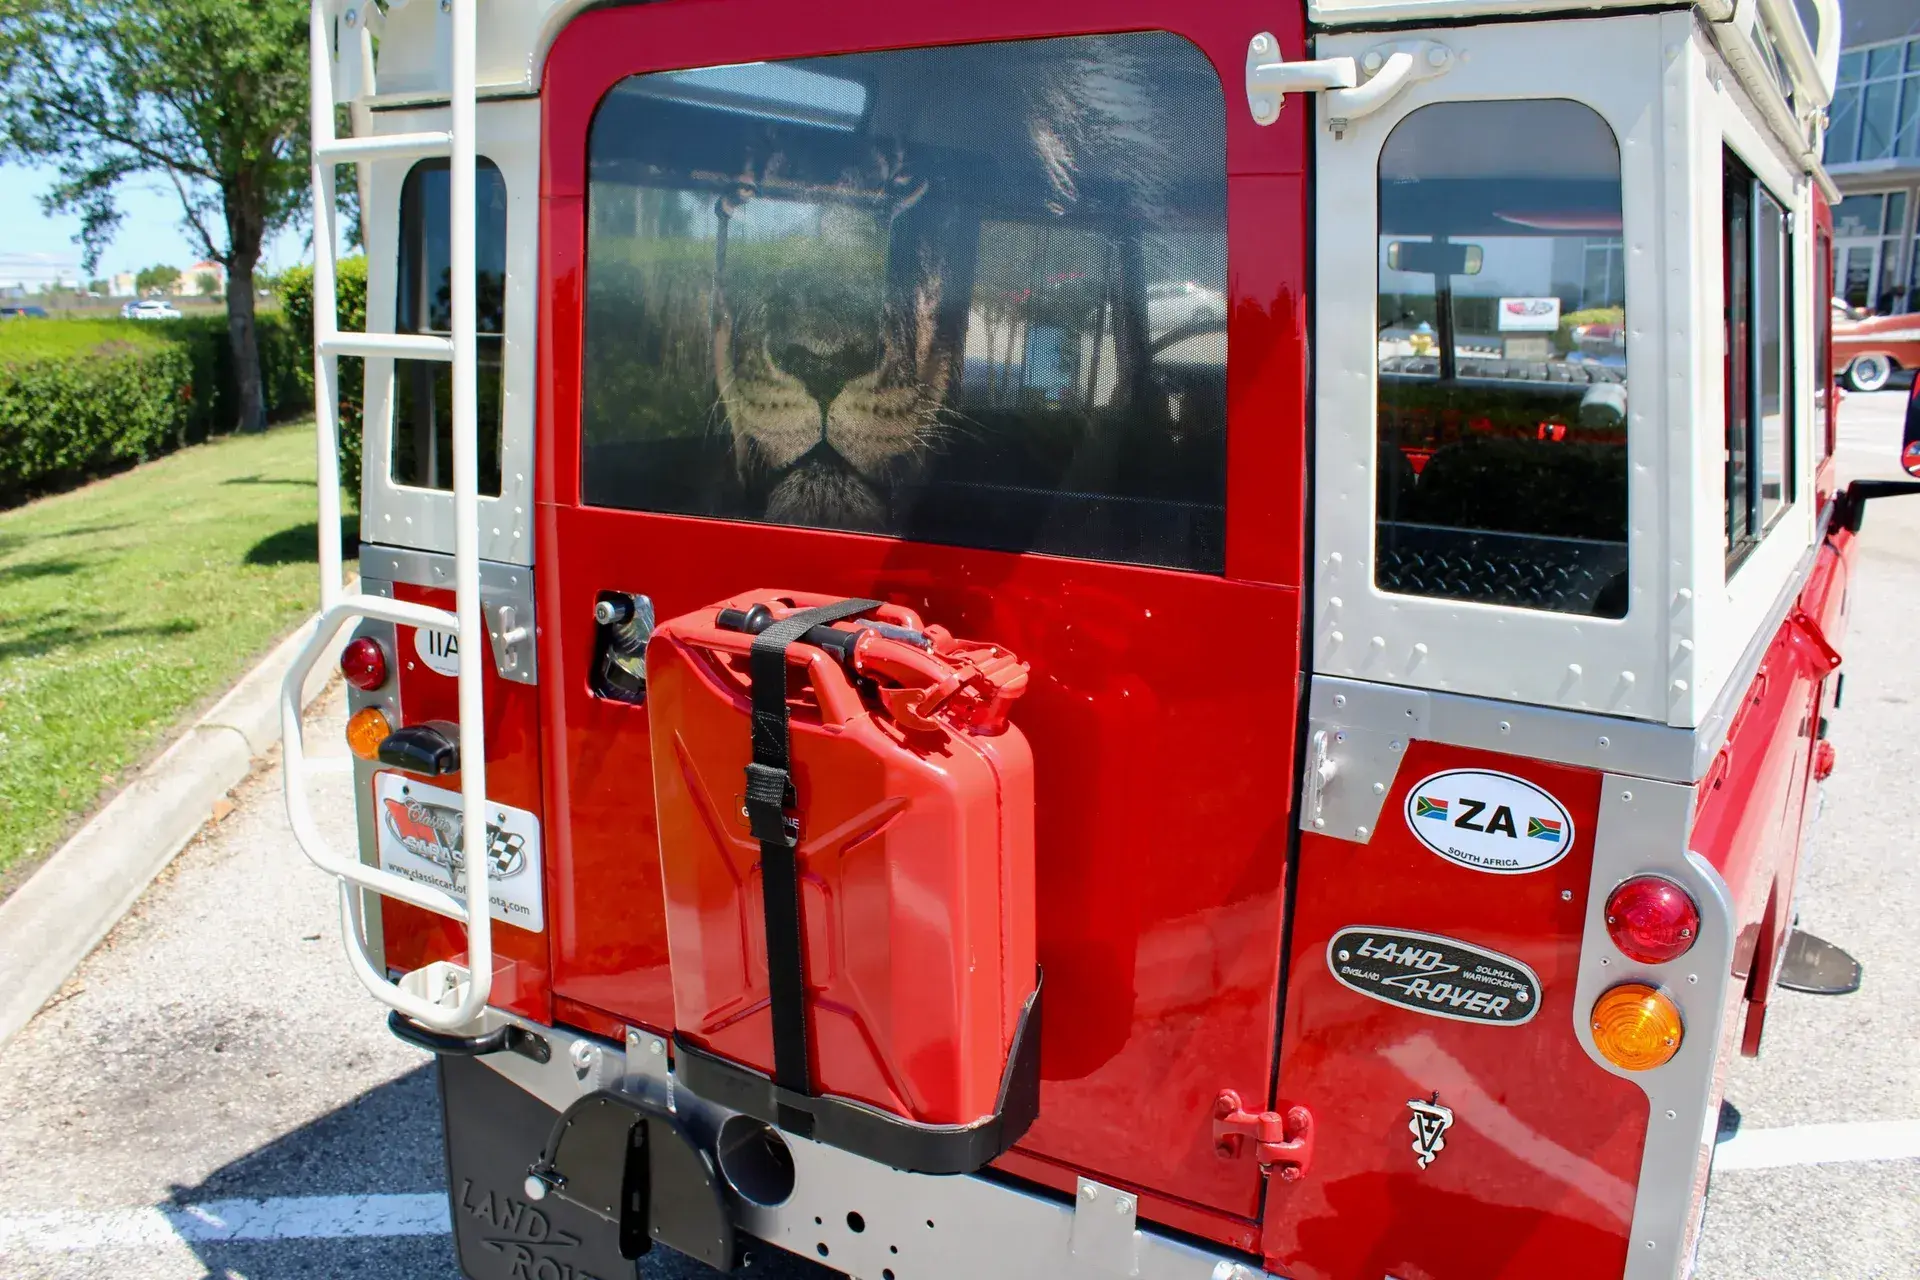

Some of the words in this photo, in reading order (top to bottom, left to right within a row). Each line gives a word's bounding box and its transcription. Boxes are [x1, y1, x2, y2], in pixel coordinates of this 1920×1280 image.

[404, 797, 451, 834] Classic
[1454, 798, 1518, 839] ZA
[403, 836, 502, 881] SARASA
[1447, 846, 1480, 863] SOUTH
[1482, 857, 1519, 867] AFRICA
[1356, 938, 1444, 972] LAND
[1341, 966, 1380, 981] ENGLAND
[1462, 971, 1529, 992] WARWICKSHIRE
[1475, 965, 1516, 981] SOLIHULL
[1404, 978, 1511, 1017] ROVER
[460, 1178, 550, 1244] LAND
